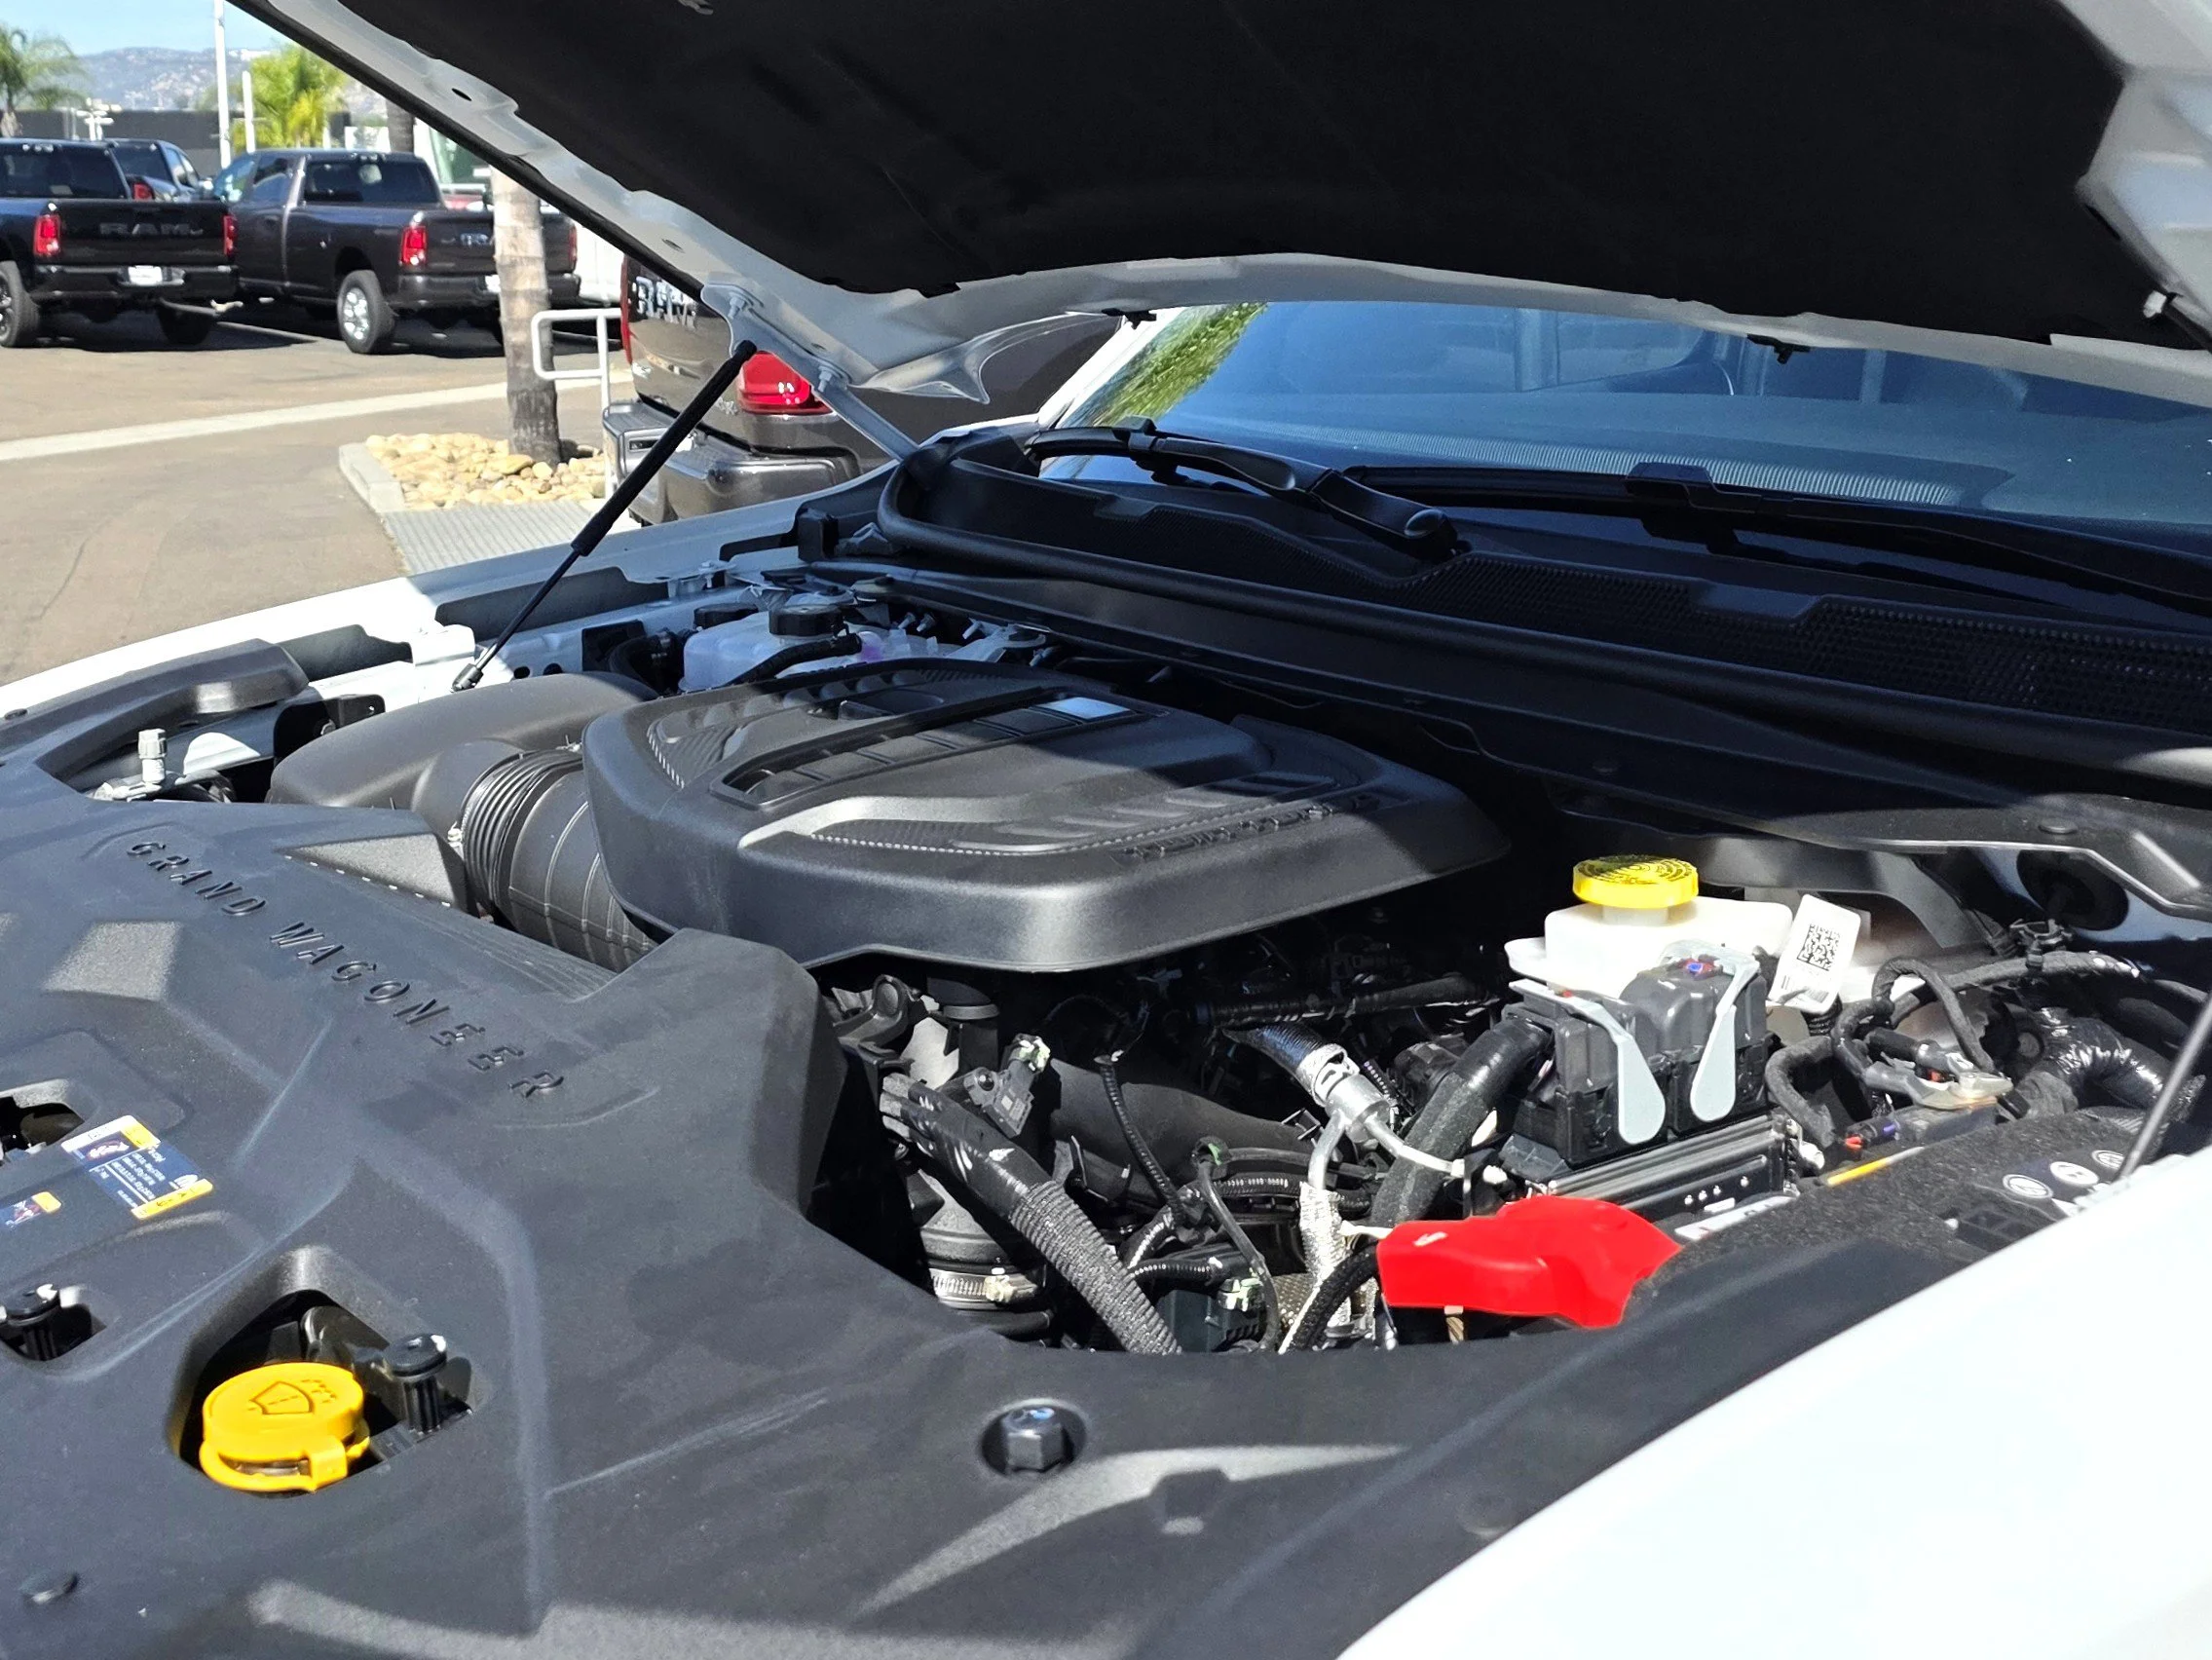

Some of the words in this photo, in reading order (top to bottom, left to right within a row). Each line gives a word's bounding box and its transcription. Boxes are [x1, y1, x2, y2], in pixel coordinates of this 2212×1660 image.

[99, 223, 189, 235] RAM
[127, 842, 266, 916] GRAND
[269, 922, 564, 1098] WAGONEER
